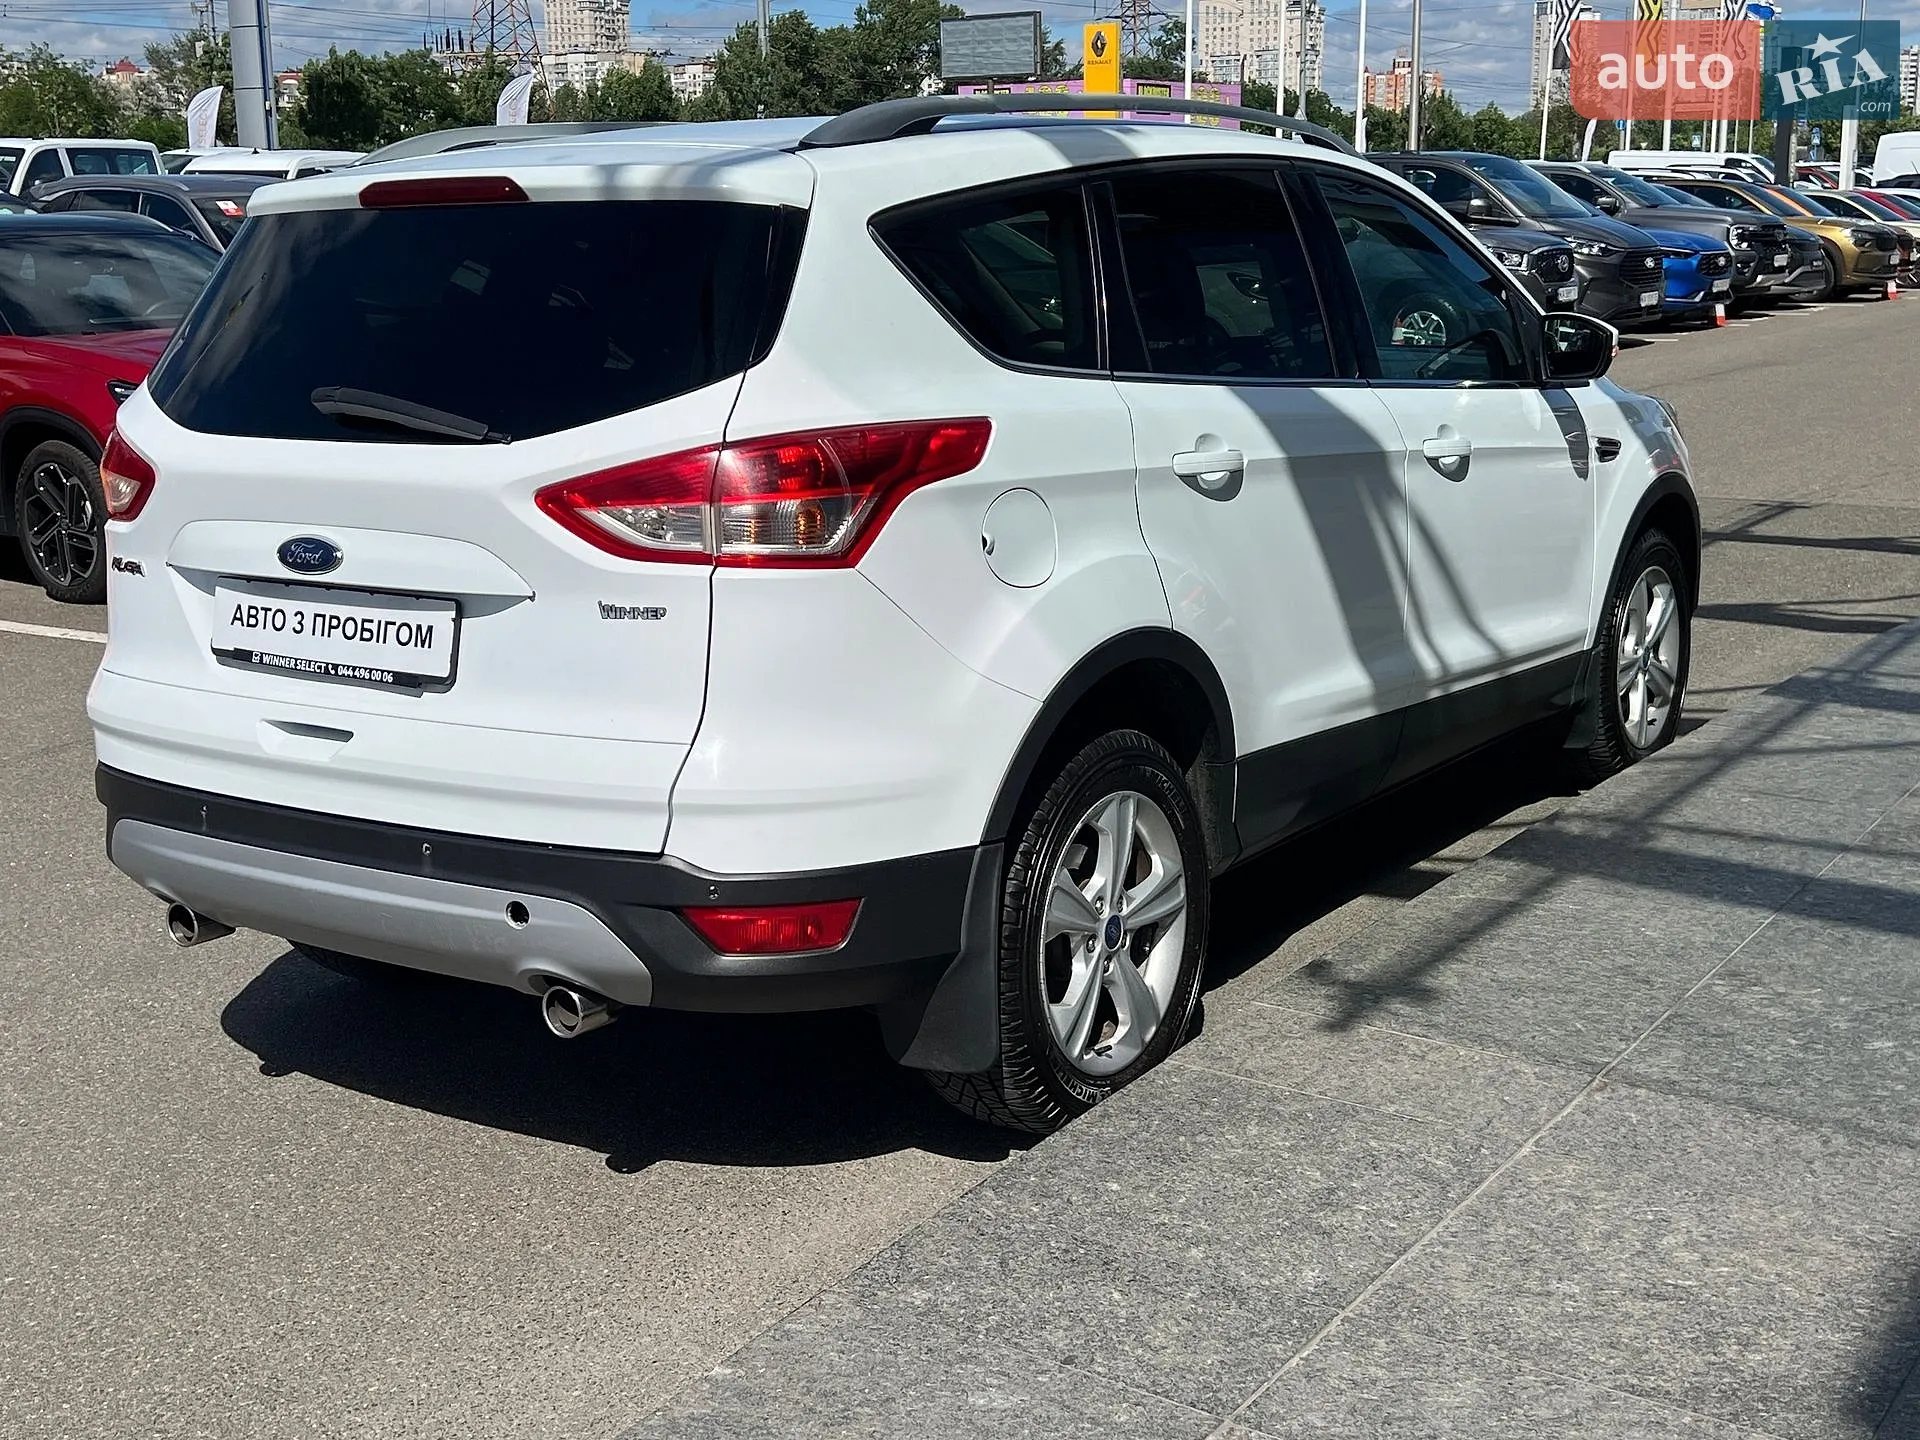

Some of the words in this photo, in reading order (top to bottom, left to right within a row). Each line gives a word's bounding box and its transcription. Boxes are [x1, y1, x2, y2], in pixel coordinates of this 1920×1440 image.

[287, 541, 323, 565] Ford
[230, 603, 287, 632] АВТО
[311, 612, 434, 649] ПРОБІГОМ
[262, 653, 296, 668] WINNER
[296, 659, 327, 674] SELECT
[337, 665, 353, 677] 044
[354, 667, 370, 680] 496
[370, 669, 382, 681] 00
[382, 671, 394, 683] 06
